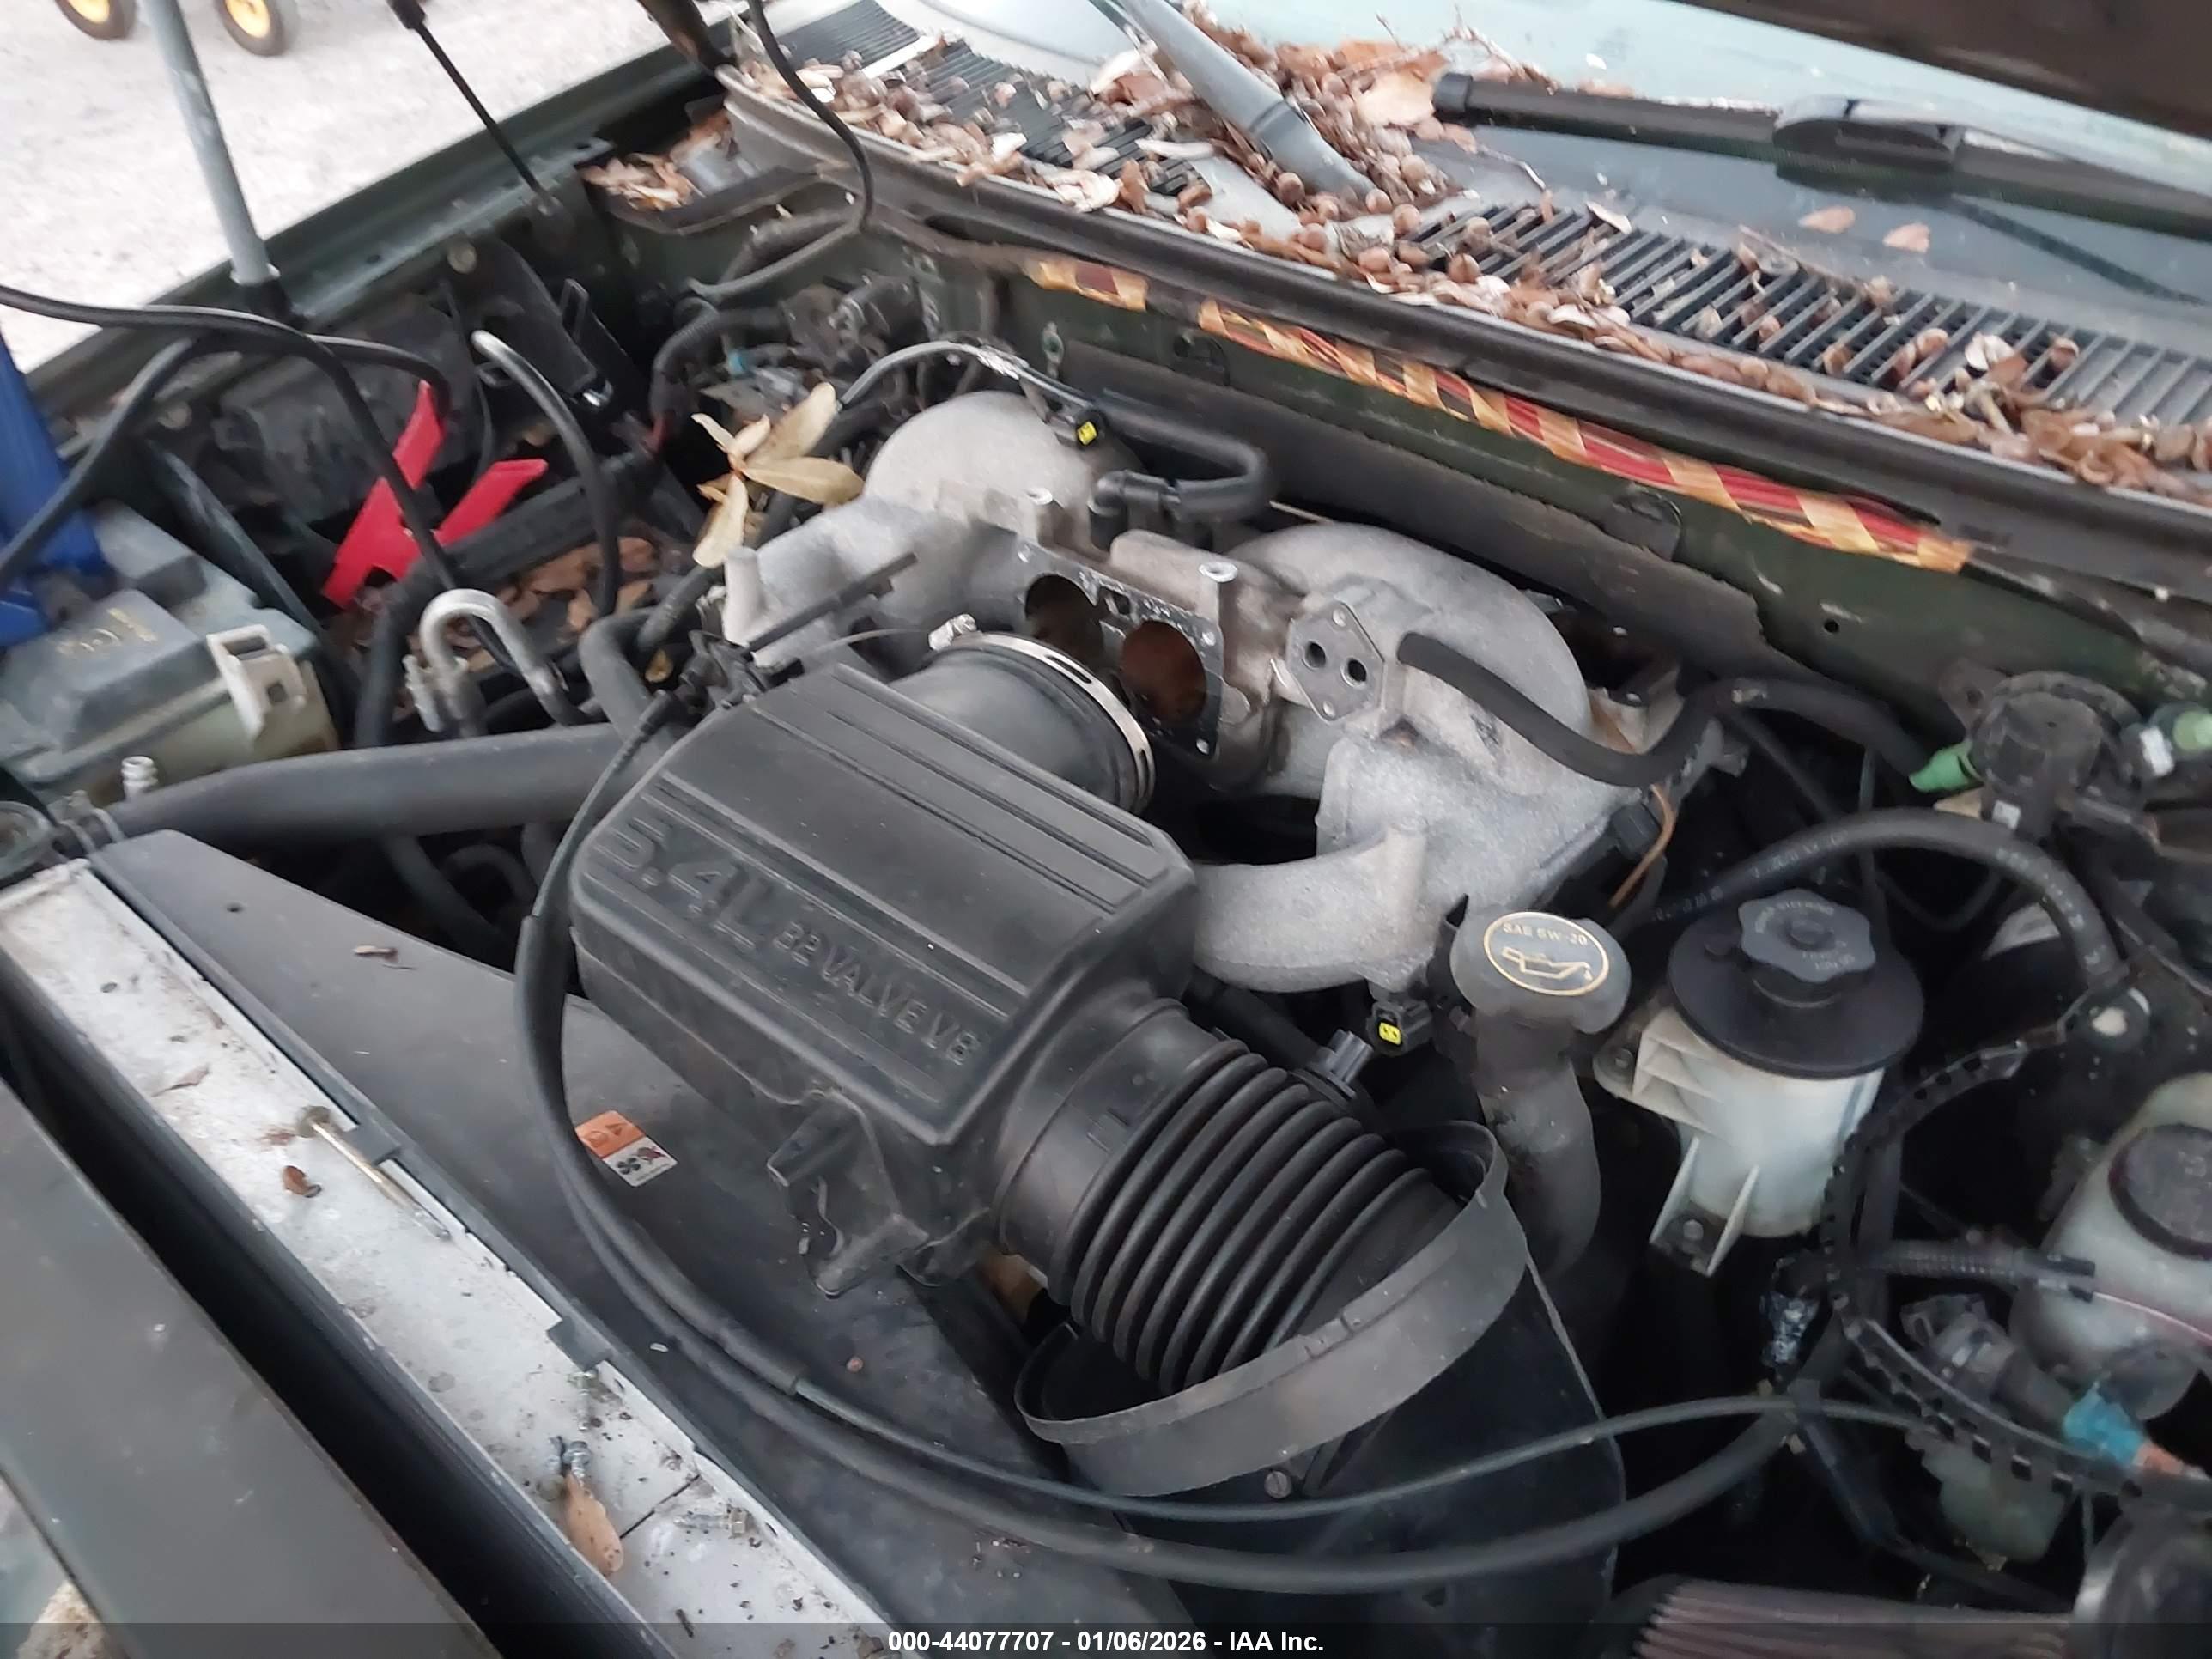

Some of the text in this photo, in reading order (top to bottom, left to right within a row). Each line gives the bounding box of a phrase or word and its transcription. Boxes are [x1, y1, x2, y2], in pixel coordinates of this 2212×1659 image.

[592, 817, 760, 951] 5.4L
[818, 943, 928, 1033] VALVE
[921, 1018, 981, 1066] V8
[1502, 921, 1534, 939] SAE
